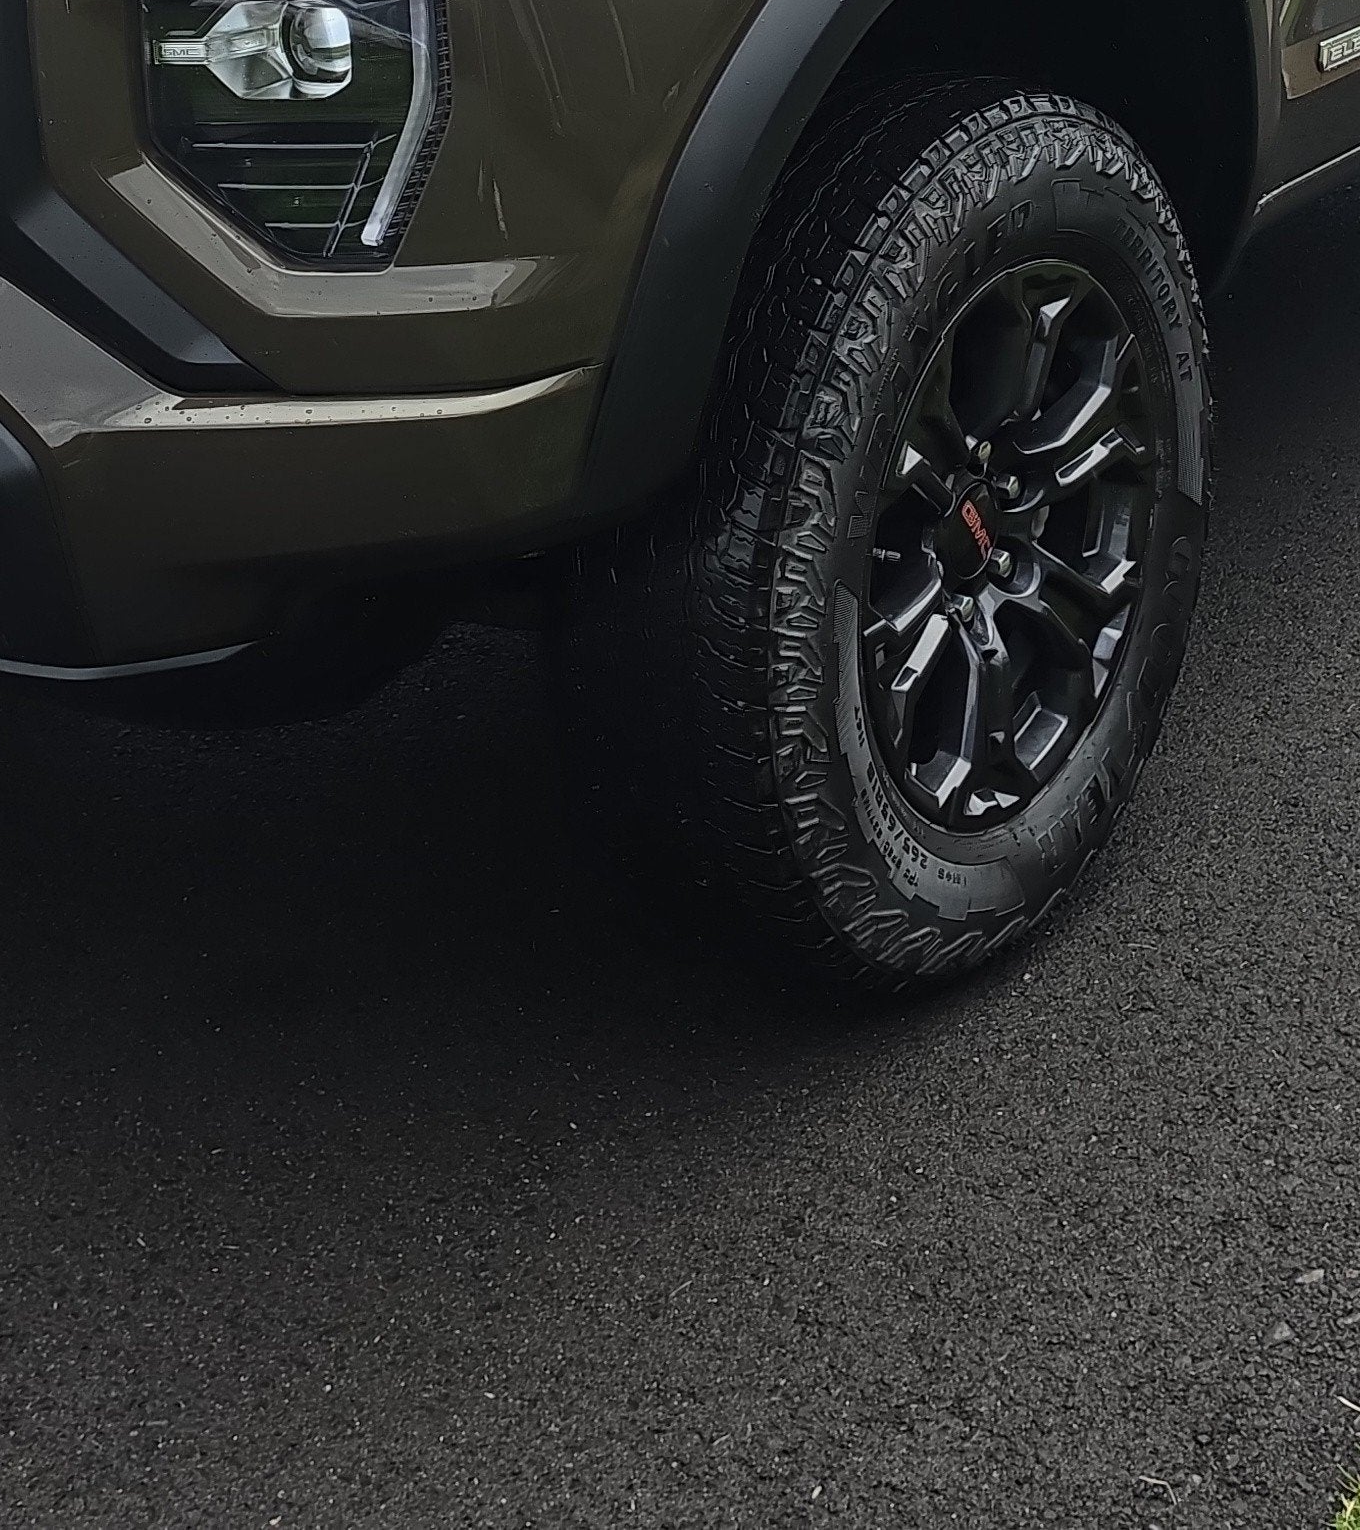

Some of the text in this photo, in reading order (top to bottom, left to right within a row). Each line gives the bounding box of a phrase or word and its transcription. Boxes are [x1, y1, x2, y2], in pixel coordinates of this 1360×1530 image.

[161, 46, 201, 58] GMC
[1114, 216, 1183, 332] TERRITORY
[1175, 351, 1193, 383] AT
[961, 499, 991, 561] GMC
